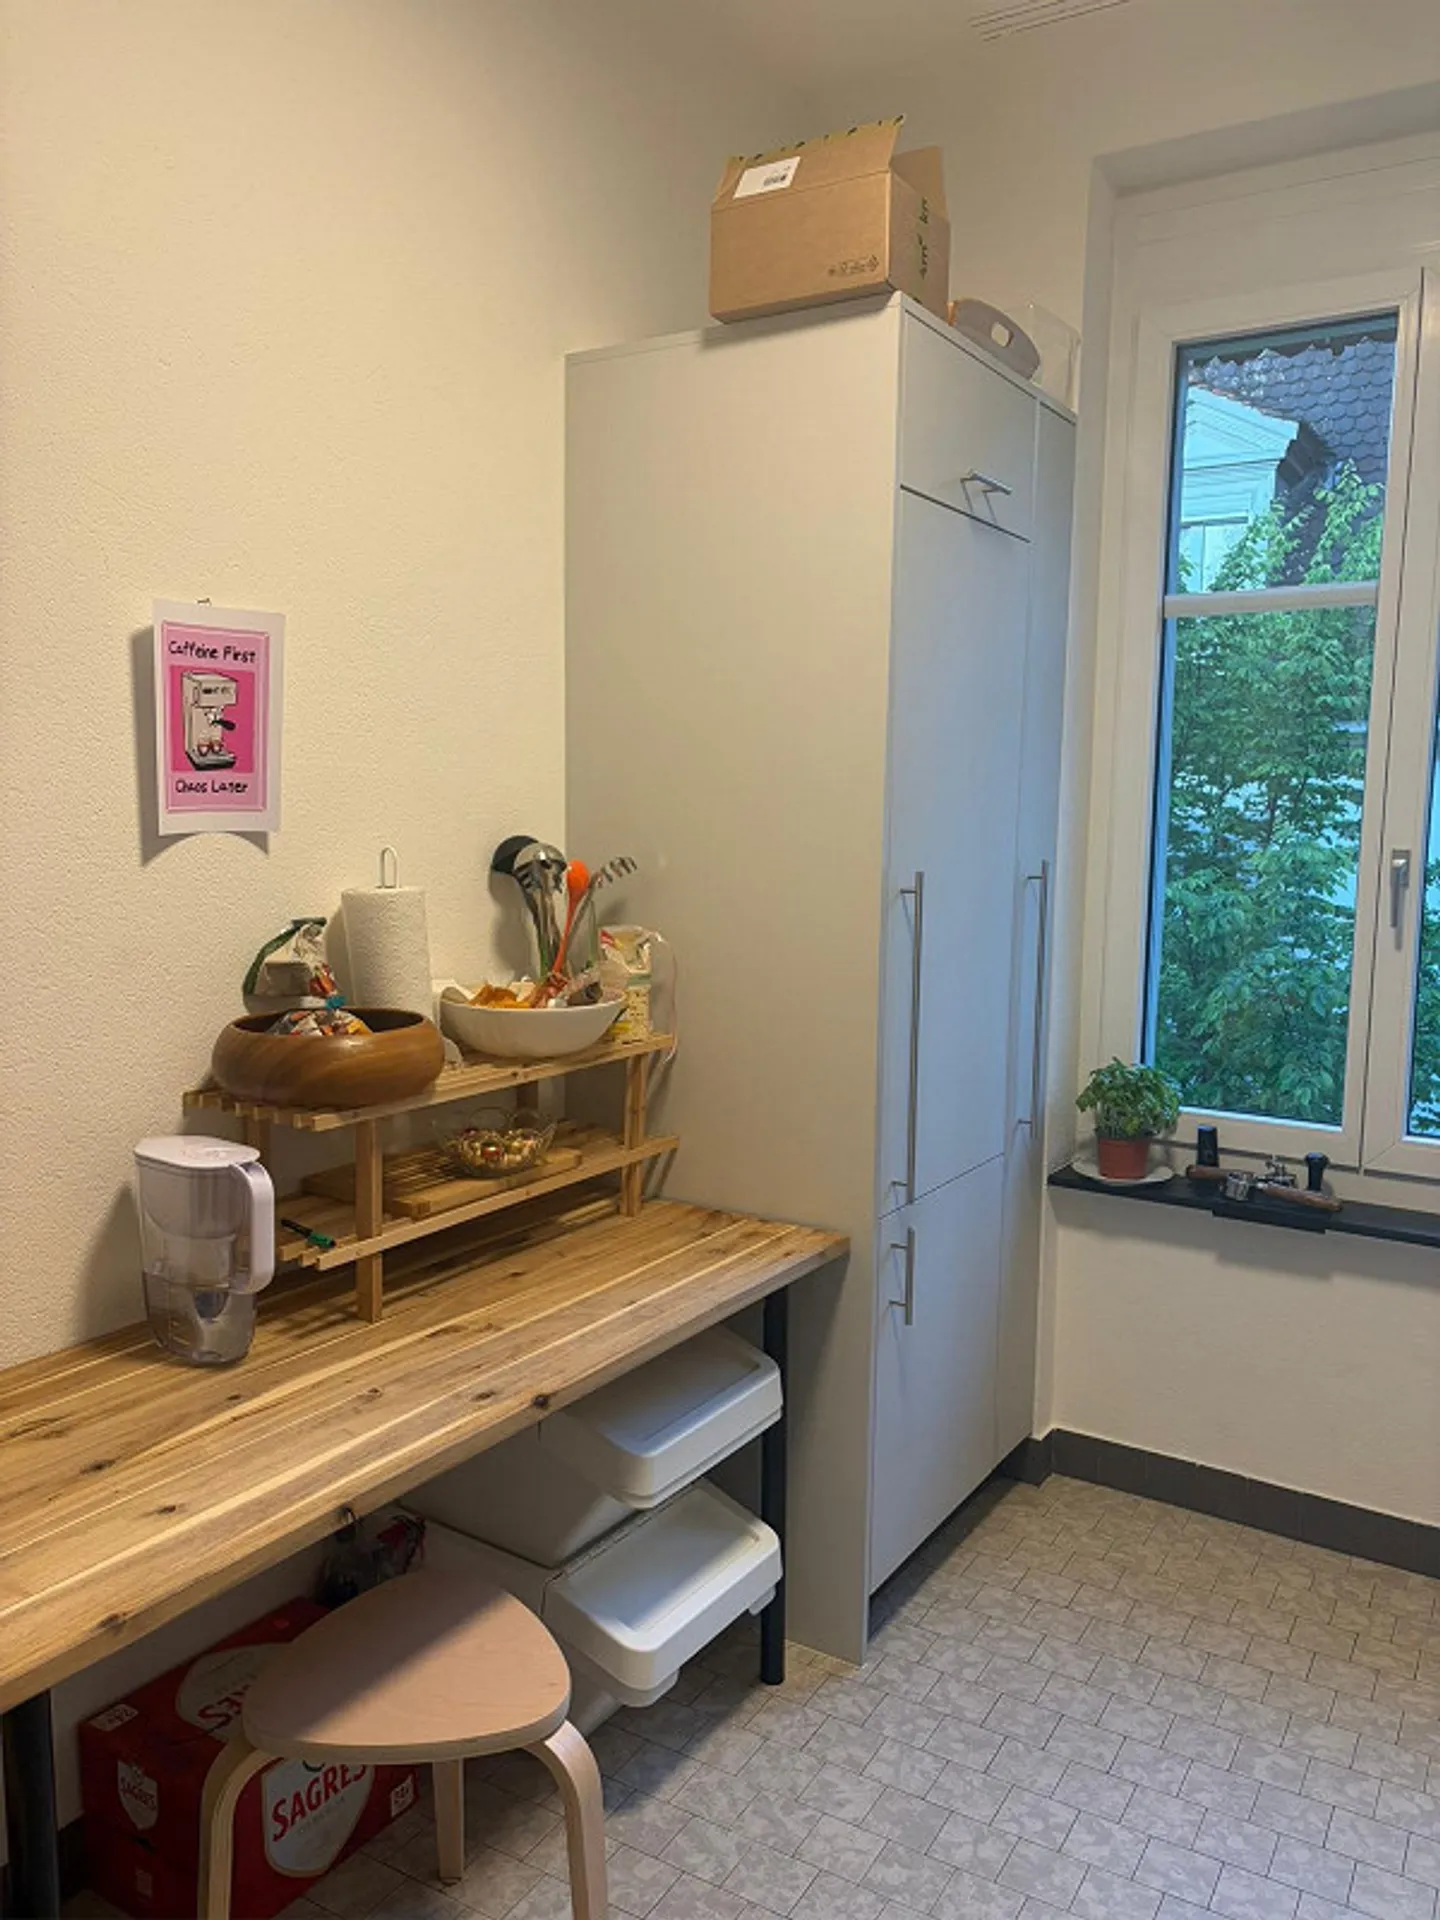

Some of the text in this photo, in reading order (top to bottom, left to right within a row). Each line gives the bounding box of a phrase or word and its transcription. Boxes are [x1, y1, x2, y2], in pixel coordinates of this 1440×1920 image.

[168, 640, 256, 664] Caffeine First
[175, 777, 208, 794] Chaos
